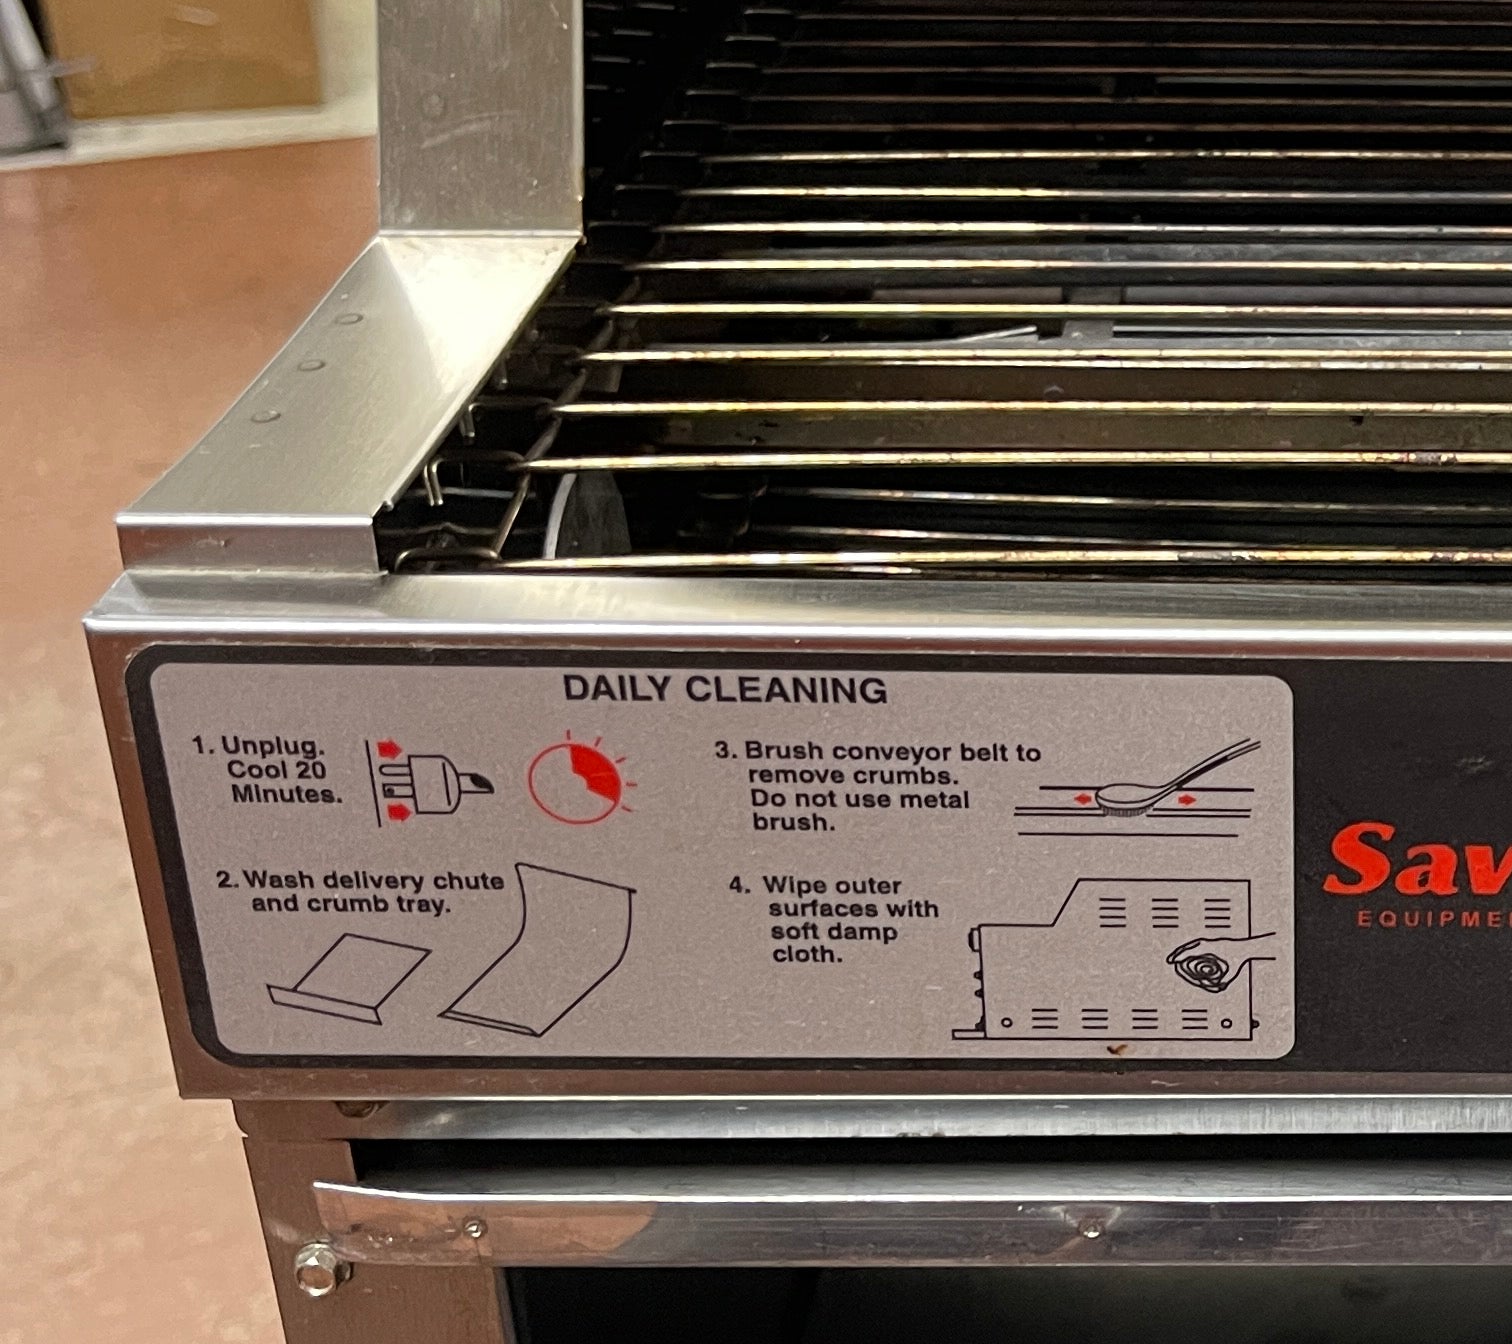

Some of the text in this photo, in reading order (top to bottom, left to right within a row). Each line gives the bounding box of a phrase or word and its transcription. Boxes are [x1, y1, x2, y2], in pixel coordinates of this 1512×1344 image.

[564, 675, 887, 704] DAILY CLEANING
[192, 736, 324, 760] 1. Unplug.
[715, 741, 1041, 765] 3. Brush conveyor belt to
[228, 760, 326, 779] Cool 20
[749, 767, 958, 785] remove crumbs.
[232, 784, 342, 803] Minutes.
[751, 789, 969, 808] Do not use metal
[753, 812, 835, 831] brush.
[217, 870, 504, 894] 2. Wash delivery chute
[730, 876, 901, 898] 4. Wipe outer
[253, 894, 450, 917] and crumb tray.
[769, 899, 938, 917] surfaces with
[772, 922, 897, 944] soft damp
[773, 945, 842, 962] cloth.
